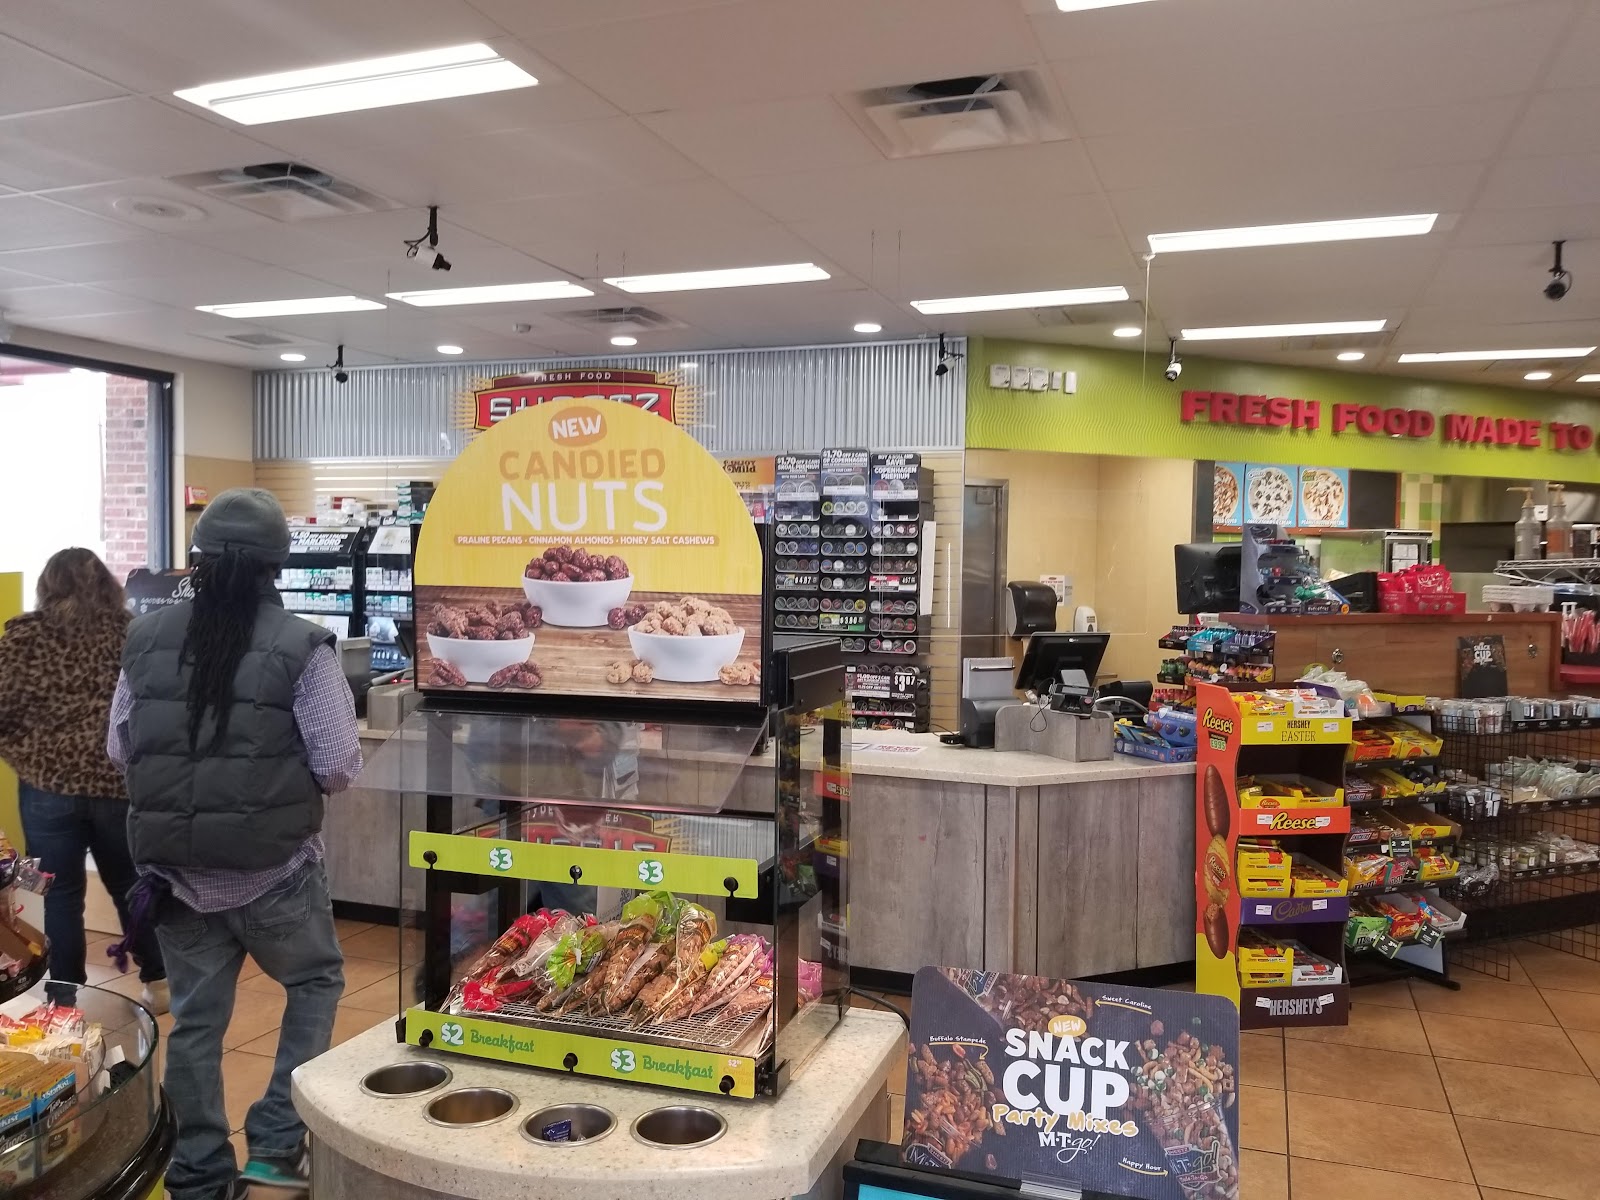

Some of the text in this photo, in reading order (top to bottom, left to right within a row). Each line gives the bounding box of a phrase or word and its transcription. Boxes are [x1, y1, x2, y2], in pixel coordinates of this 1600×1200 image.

[533, 371, 612, 382] FRESH FOOD
[551, 415, 602, 440] NEW
[1181, 390, 1592, 452] FRESH FOOD MADE TO
[499, 448, 666, 481] CANDIED
[501, 481, 668, 532] NUTS
[457, 535, 715, 546] PRALINE PECANS CINNAMON ALMONDS HONEY SALT CASHEWS
[1474, 651, 1492, 661] CUP
[1203, 707, 1234, 734] Reese's
[1287, 720, 1311, 729] HERSHEY
[1281, 731, 1316, 742] EASTER
[489, 848, 513, 871] $3
[638, 860, 664, 883] $3
[1102, 994, 1152, 1010] Sweet Caroline
[1270, 998, 1323, 1016] HERSHEY'S
[441, 1022, 535, 1054] $2 Breakfast
[1053, 1020, 1081, 1034] NEW
[929, 1035, 987, 1045] Buffalo Stampede
[1004, 1028, 1131, 1070] SNACK
[610, 1048, 713, 1080] $3 Breakfast
[1002, 1060, 1130, 1119] CUP
[992, 1104, 1139, 1137] Party Mixes
[1122, 1157, 1161, 1171] Happy Hour
